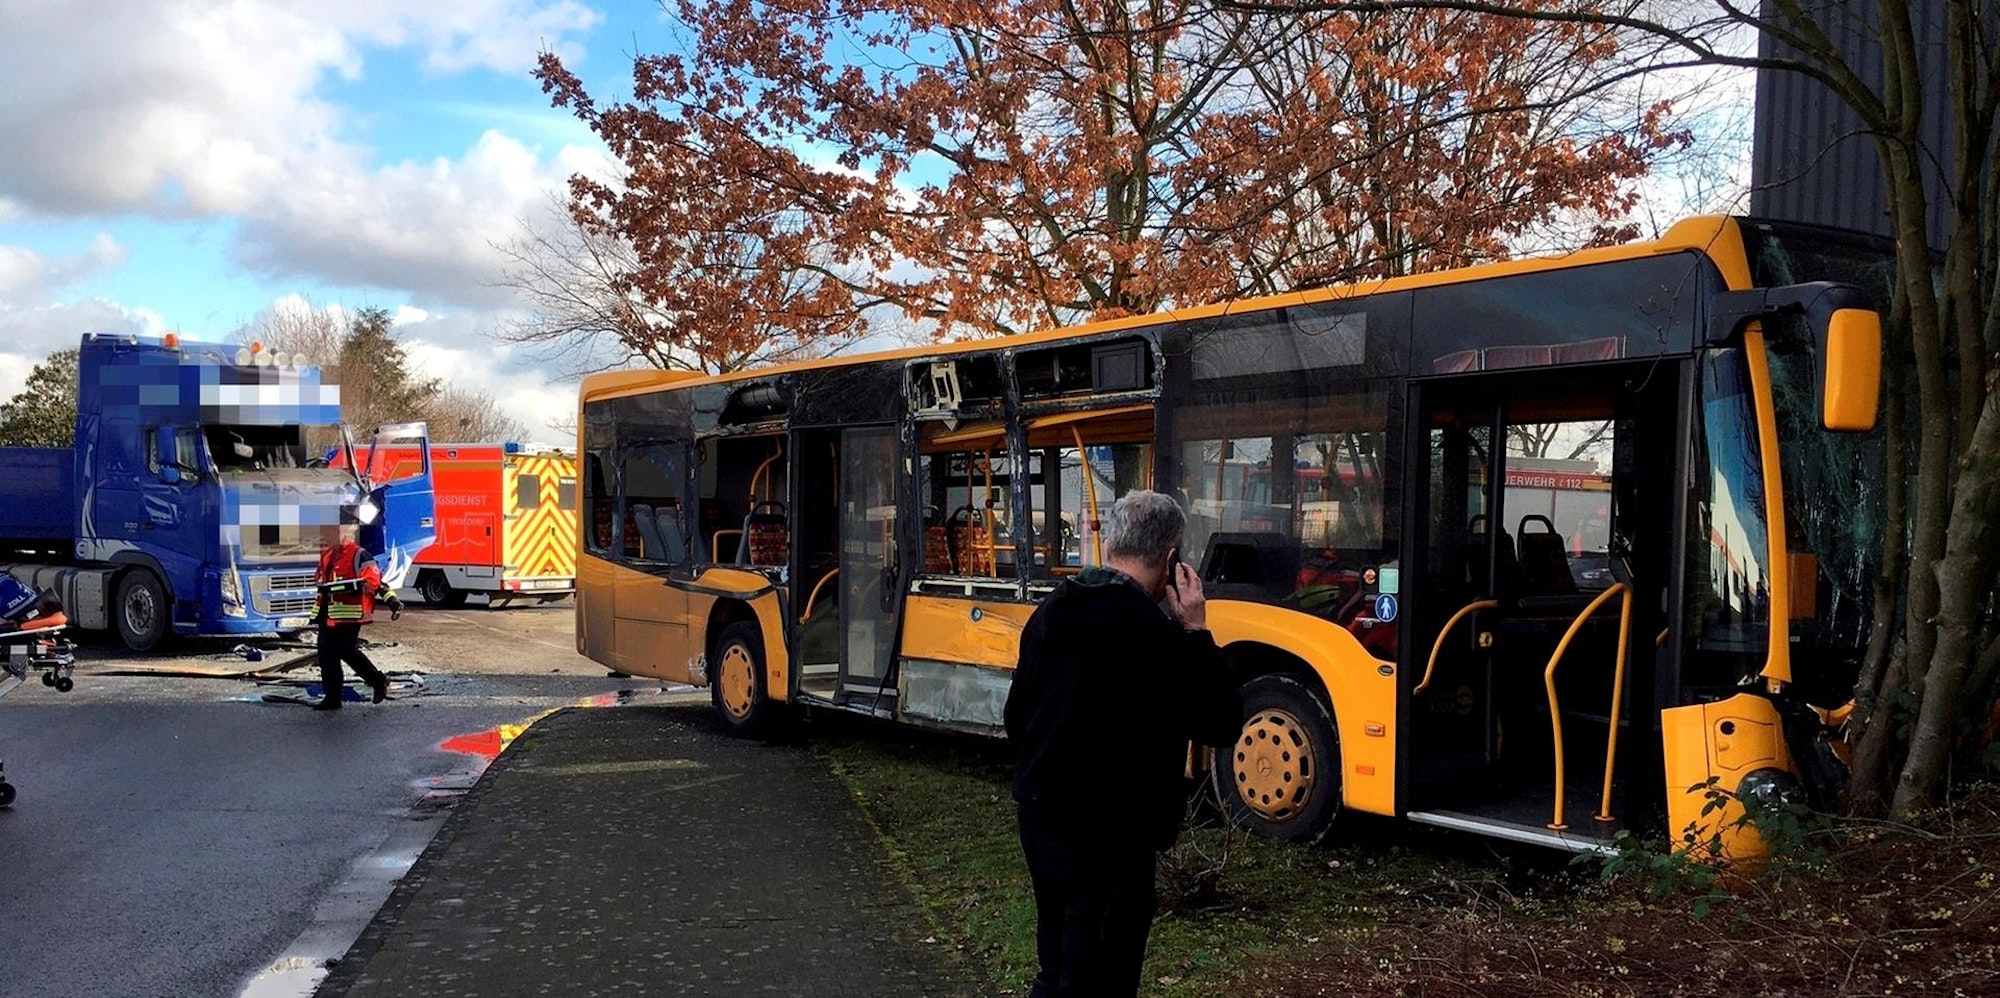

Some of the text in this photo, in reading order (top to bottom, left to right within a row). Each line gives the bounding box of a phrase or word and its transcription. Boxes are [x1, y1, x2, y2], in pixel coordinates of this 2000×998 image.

[1566, 478, 1581, 488] 112
[435, 495, 486, 506] GSDIENST
[7, 595, 26, 609] ZOLL
